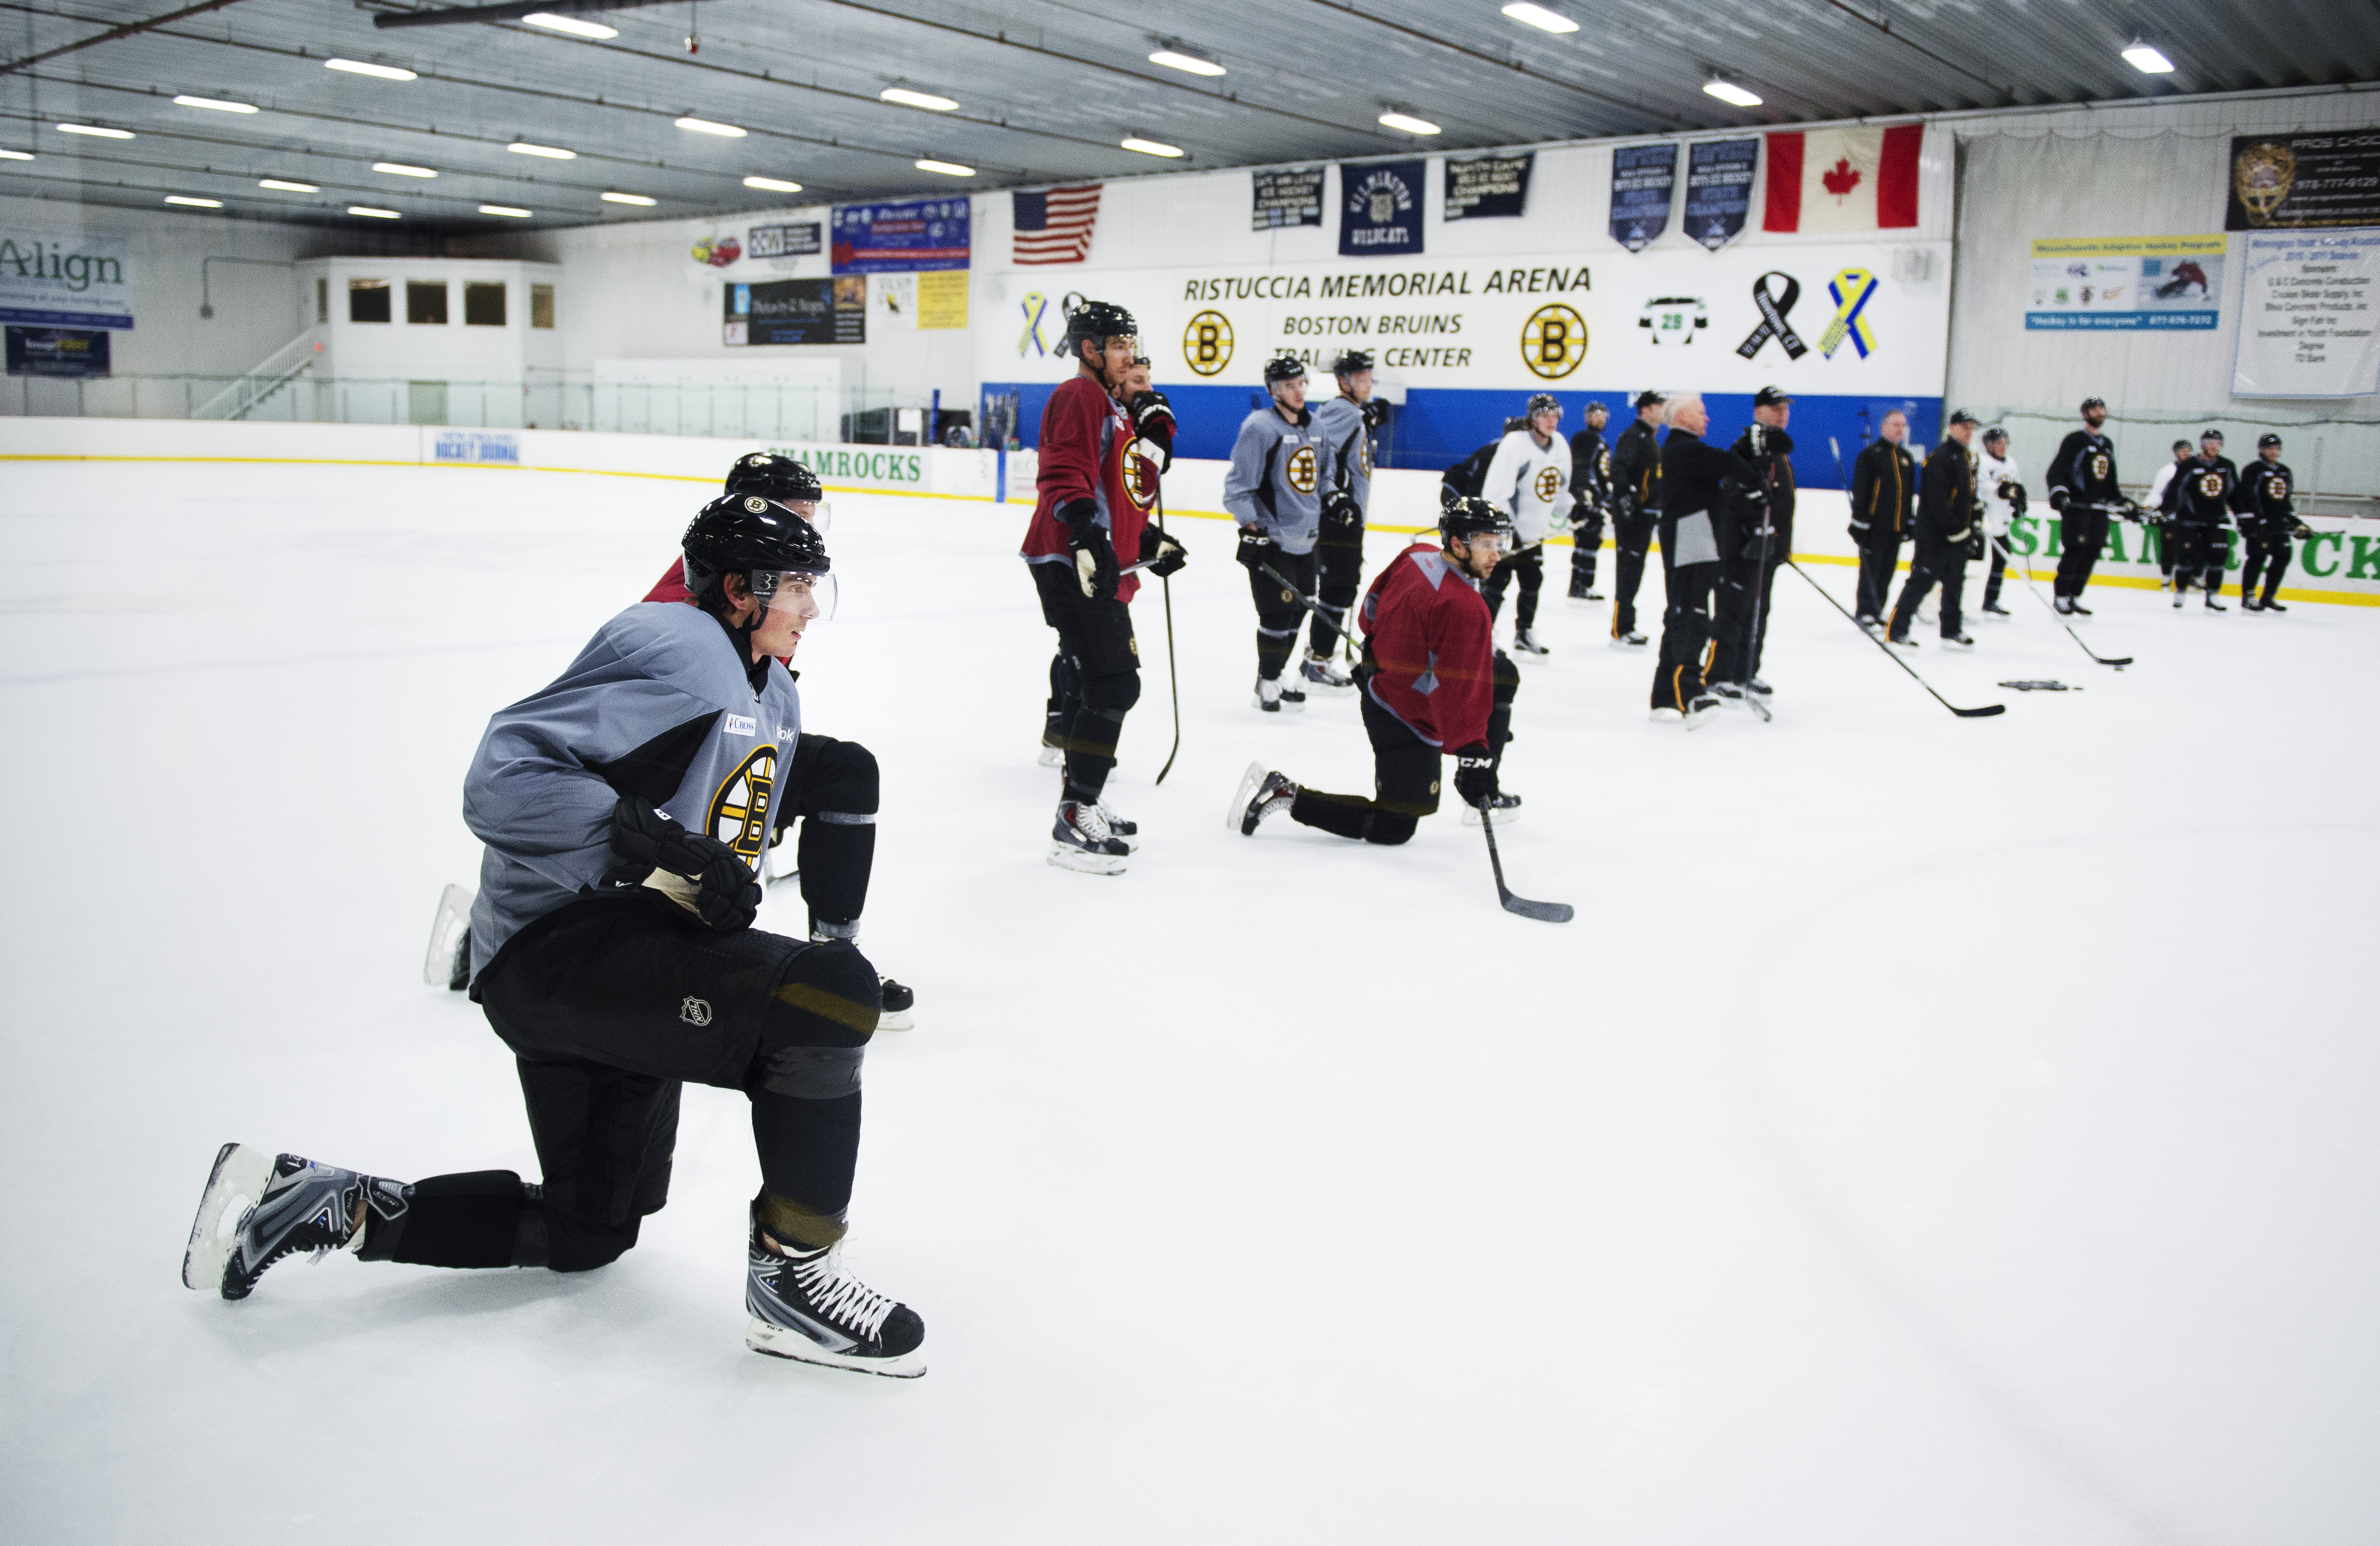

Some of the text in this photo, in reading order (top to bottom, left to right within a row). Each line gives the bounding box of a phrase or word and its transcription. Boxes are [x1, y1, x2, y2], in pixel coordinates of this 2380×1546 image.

[1352, 226, 1409, 245] WILDCATS
[2145, 242, 2178, 251] Hockey
[0, 238, 124, 291] Align
[1184, 266, 1592, 301] RISTUCCIA MEMORIAL ARENA
[1284, 314, 1463, 335] BOSTON BRUINS
[1273, 347, 1472, 367] TRAIG CENTER
[767, 447, 922, 482] AMROCKS
[2009, 516, 2380, 580] SAMCK
[1457, 756, 1493, 768] CM
[690, 1003, 704, 1022] NHL
